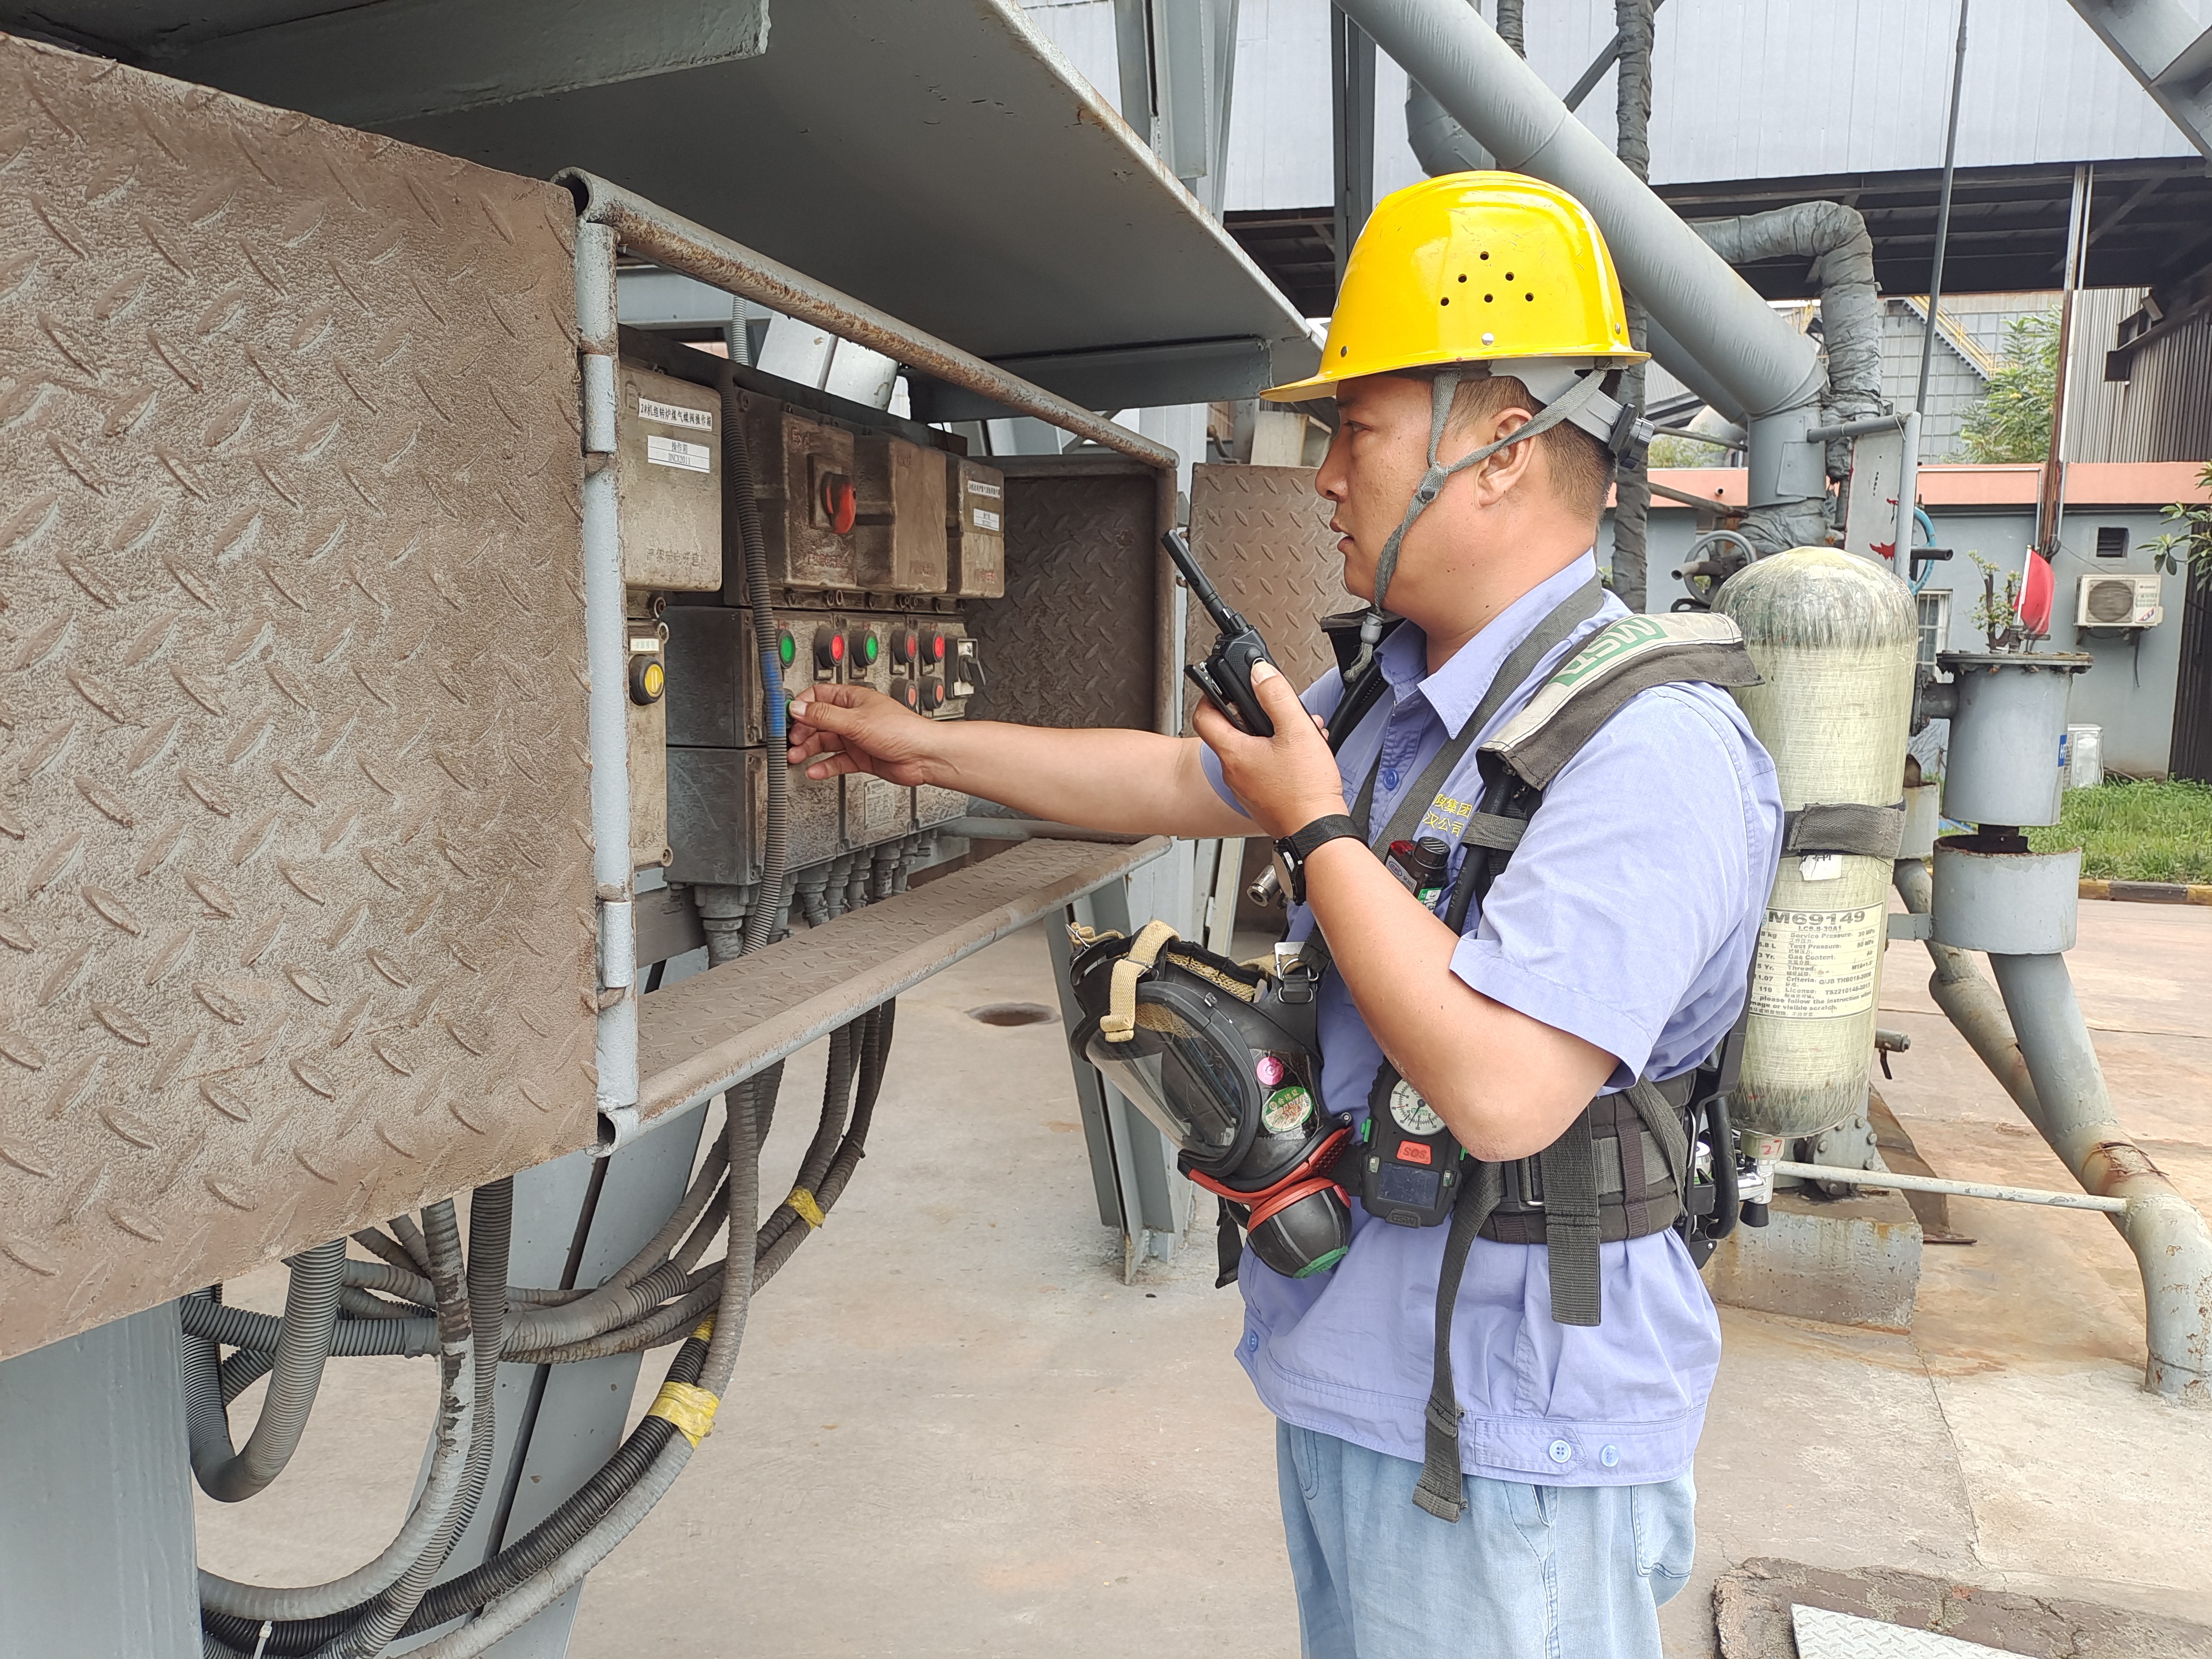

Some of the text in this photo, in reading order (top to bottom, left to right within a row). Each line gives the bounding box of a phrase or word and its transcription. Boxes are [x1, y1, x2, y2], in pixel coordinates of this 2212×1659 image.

[1769, 910, 1866, 926] M69149
[1402, 1146, 1427, 1159] SOS
[1761, 1138, 1783, 1156] 27
